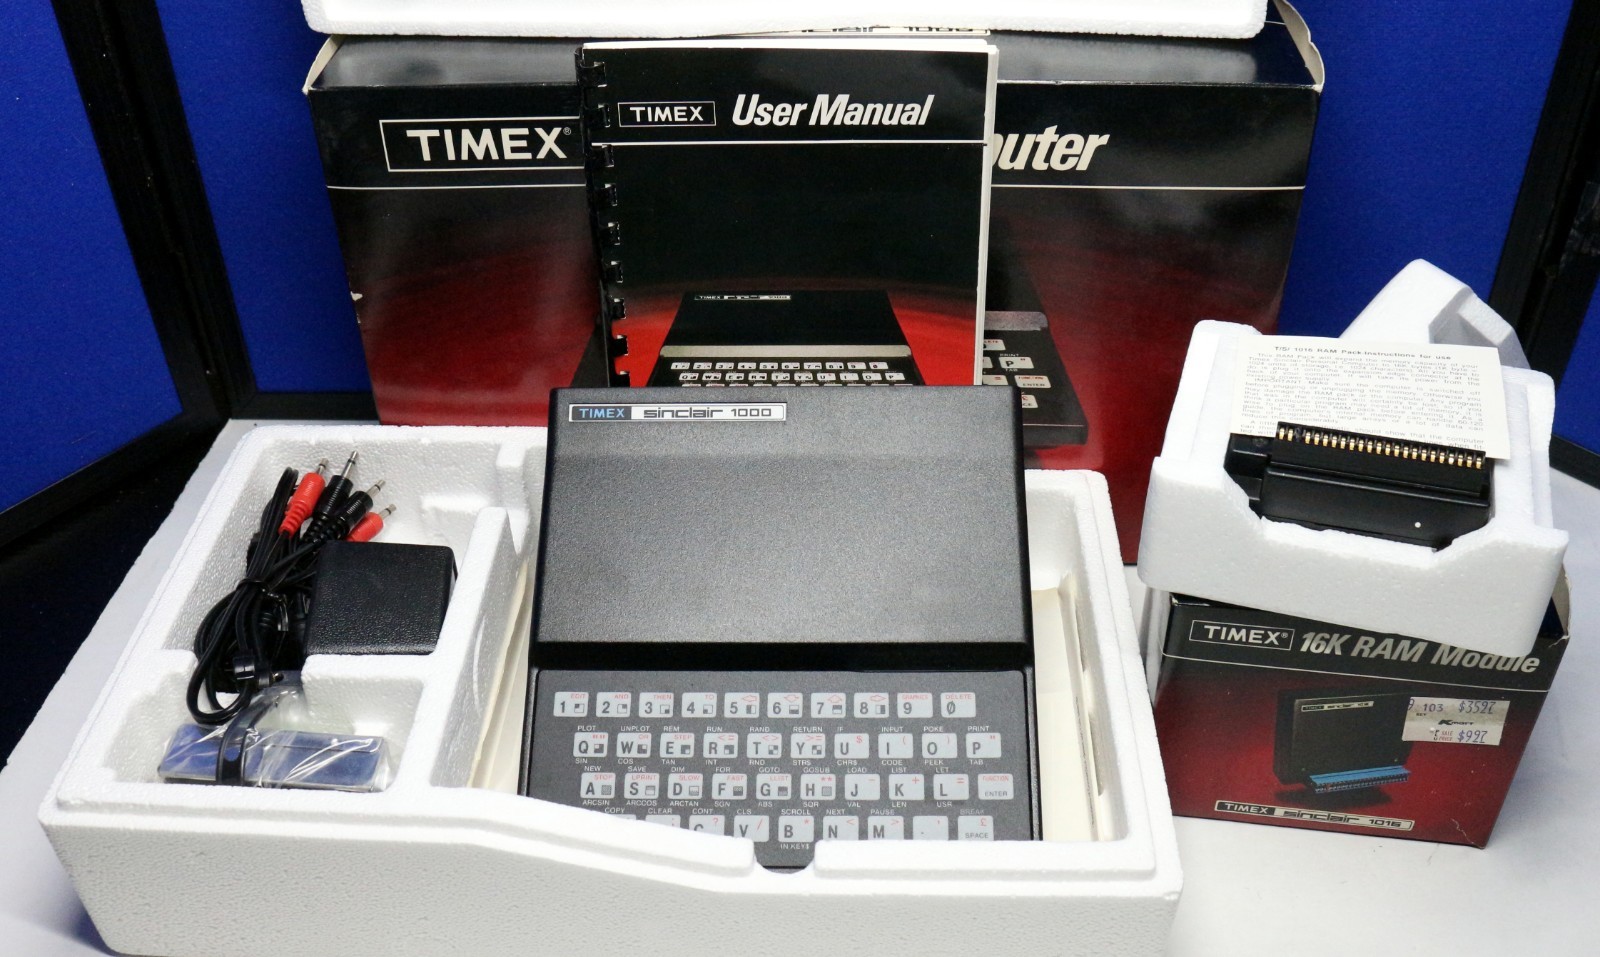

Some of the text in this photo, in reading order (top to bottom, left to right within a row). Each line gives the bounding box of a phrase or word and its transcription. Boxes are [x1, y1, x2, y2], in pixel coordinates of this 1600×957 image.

[630, 106, 704, 122] TIMEX
[732, 94, 935, 126] User Manual
[579, 407, 771, 418] TIMEX sinclair 1000
[1300, 632, 1349, 656] 16K
[1351, 635, 1428, 662] RAM
[560, 701, 566, 713] 1
[602, 701, 610, 714] 2
[644, 701, 653, 714] 3
[686, 702, 695, 714] 4
[730, 702, 738, 714] 5
[773, 702, 781, 715] 6
[816, 702, 824, 715] 7
[860, 702, 868, 715] 8
[903, 702, 912, 714] 9
[1423, 703, 1443, 712] 103
[578, 740, 588, 754] Q
[621, 741, 634, 754] W
[665, 741, 674, 754] E
[708, 742, 718, 755] R
[753, 742, 761, 755] T
[796, 742, 805, 755] Y
[840, 742, 849, 755] U
[927, 742, 938, 755] O
[972, 741, 981, 754] P
[585, 782, 595, 795] A
[629, 782, 639, 796] S
[673, 783, 682, 796] D
[718, 783, 726, 796] F
[760, 783, 771, 796] G
[806, 783, 815, 796] H
[850, 784, 858, 797] J
[895, 783, 904, 796] K
[940, 783, 948, 796] L
[1224, 802, 1401, 828] TIMEX sinclair 1016
[739, 824, 748, 837] V
[784, 824, 794, 838] B
[828, 825, 838, 838] N
[873, 825, 885, 838] M
